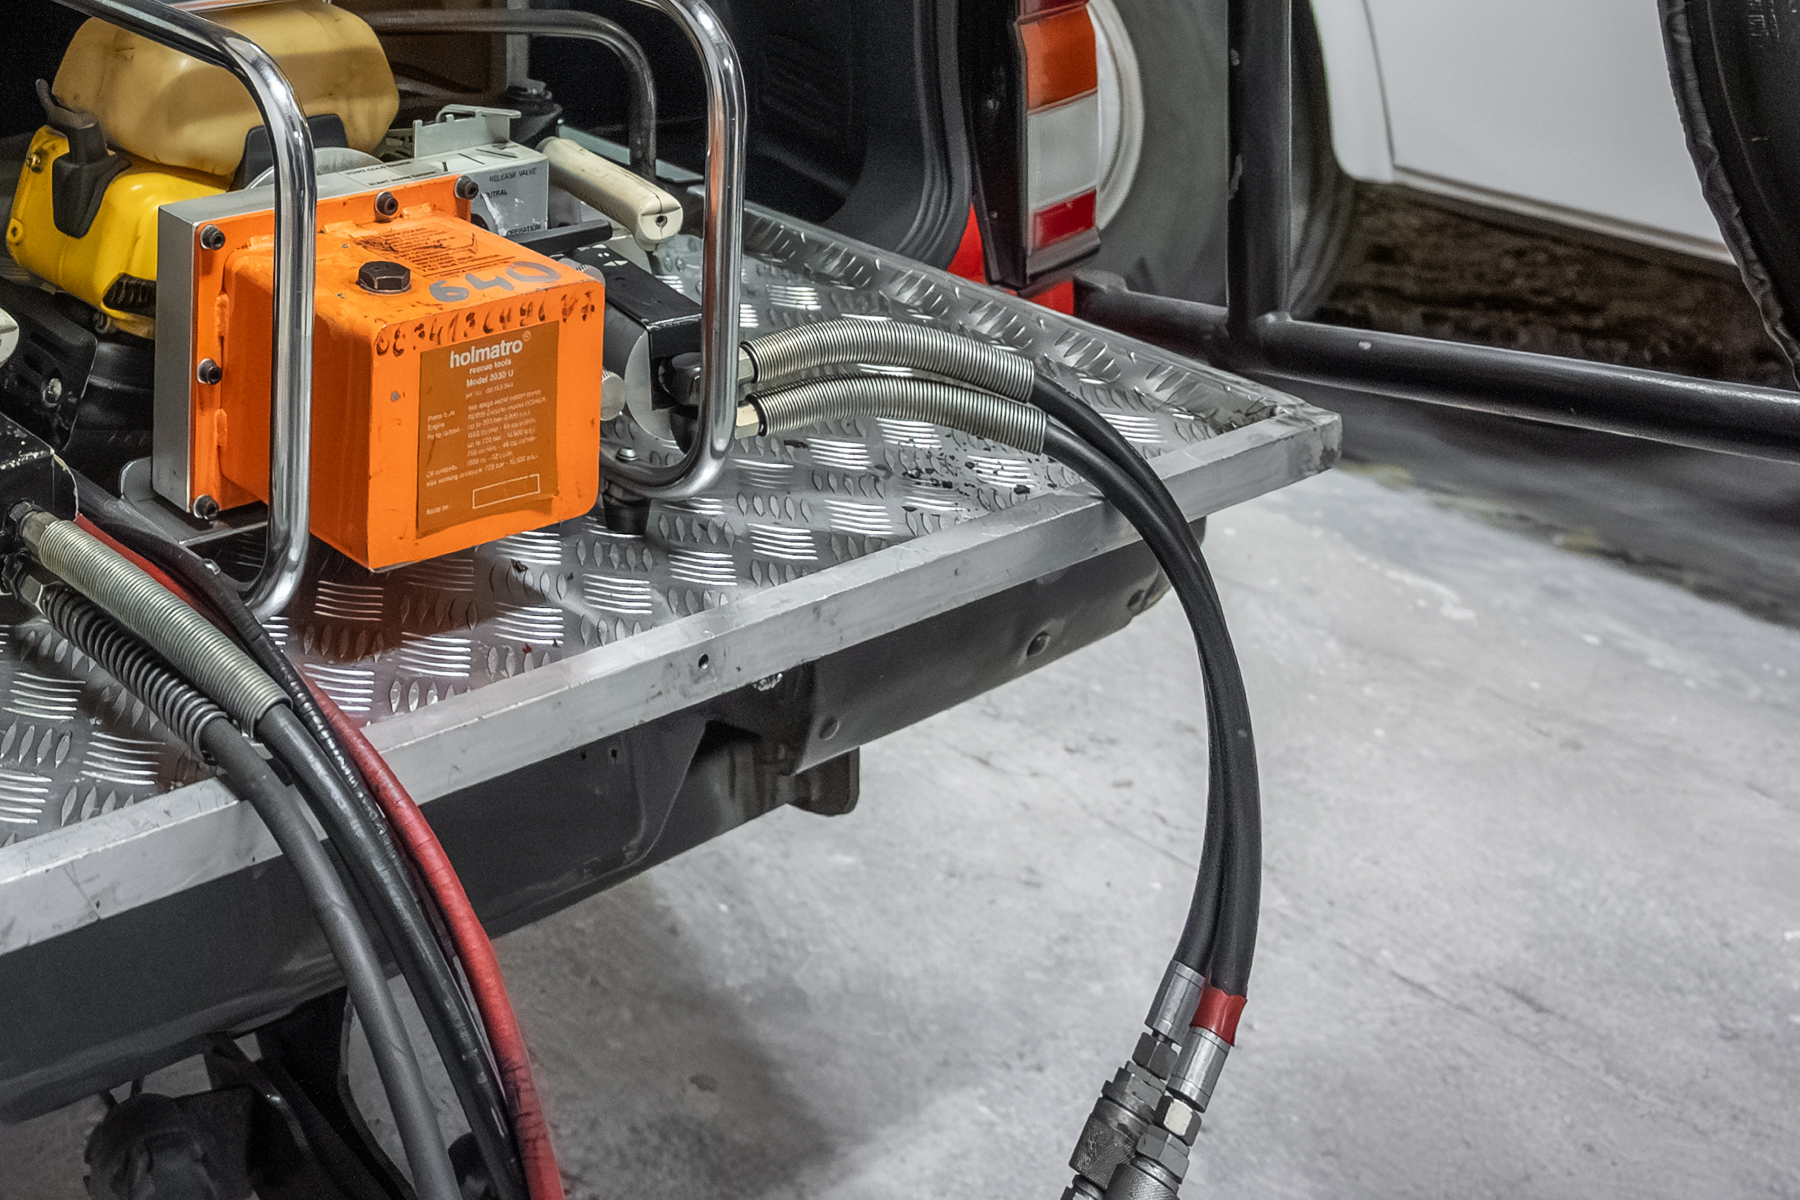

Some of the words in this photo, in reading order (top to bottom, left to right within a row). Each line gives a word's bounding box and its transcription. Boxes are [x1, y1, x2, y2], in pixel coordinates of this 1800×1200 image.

[489, 171, 517, 183] RELEASE
[518, 166, 538, 177] VALVE
[429, 261, 561, 303] 640
[449, 339, 523, 369] holmatro
[469, 362, 493, 375] rescue
[494, 358, 512, 368] tools
[466, 375, 488, 388] Model
[489, 371, 507, 382] 2030
[508, 368, 514, 378] U
